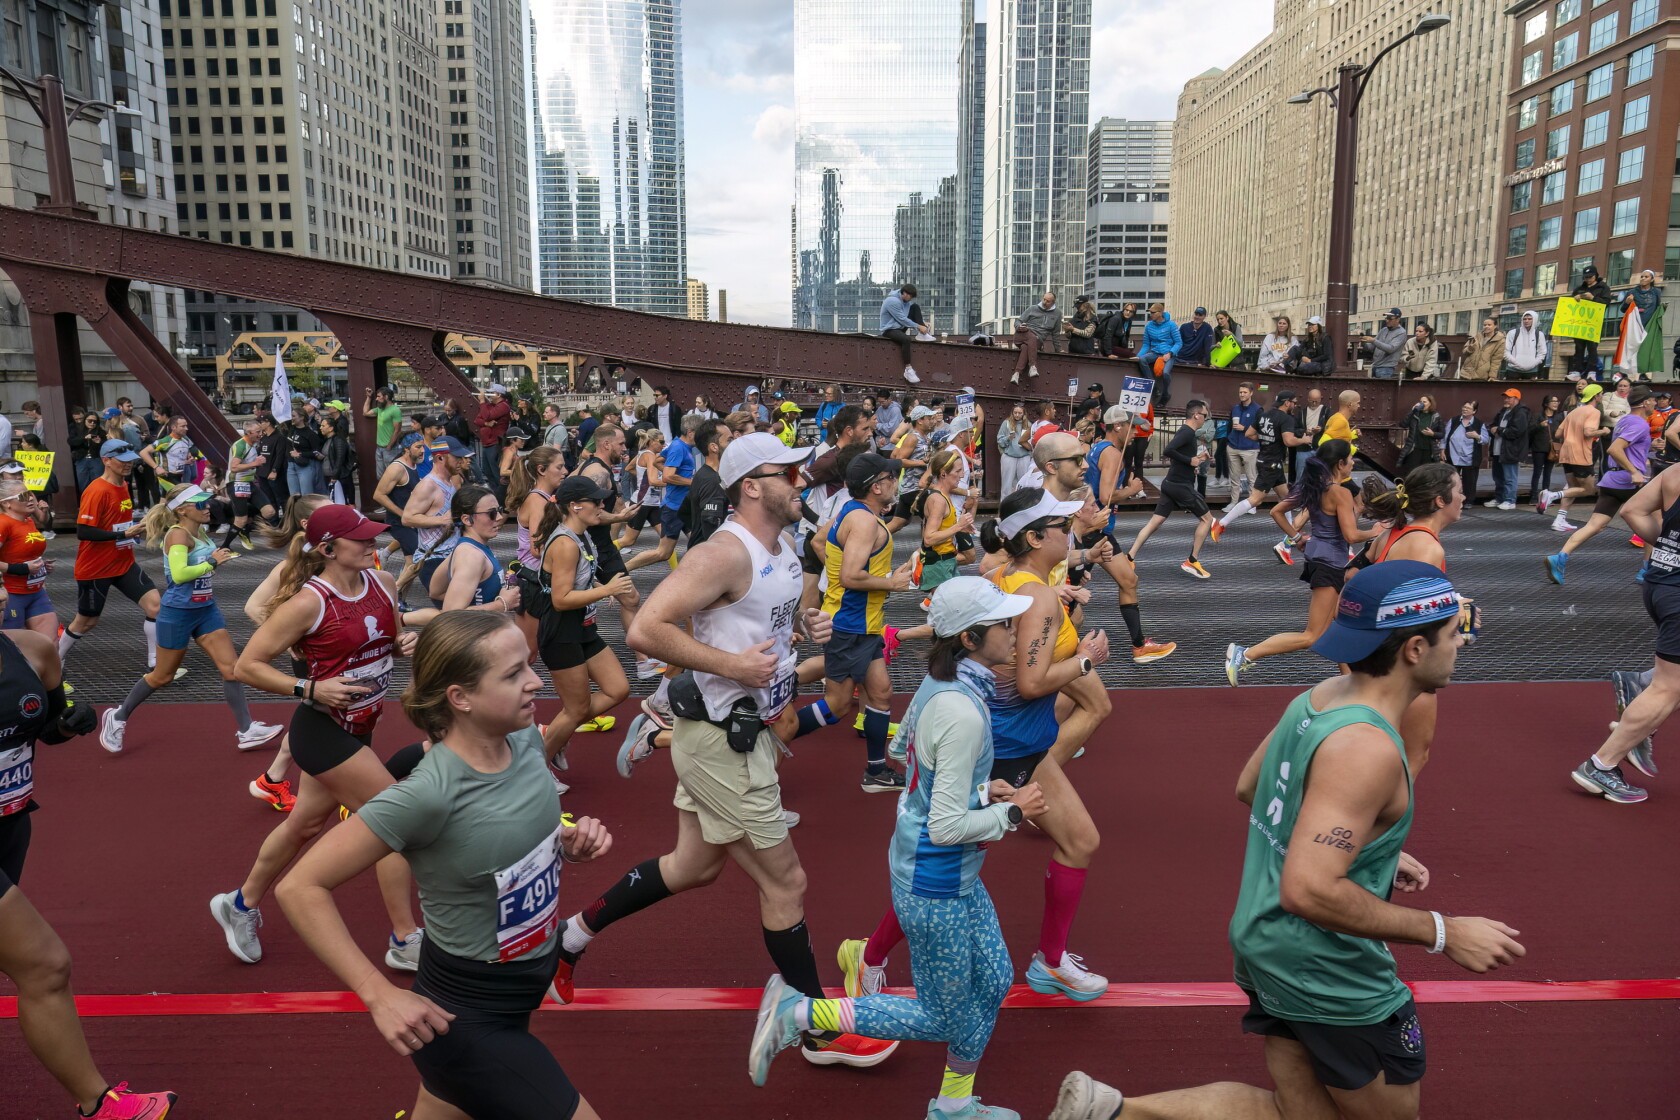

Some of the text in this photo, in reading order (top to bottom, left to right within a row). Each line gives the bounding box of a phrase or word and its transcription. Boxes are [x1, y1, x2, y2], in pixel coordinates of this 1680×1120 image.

[1567, 303, 1596, 319] YOU
[1558, 323, 1595, 339] THIS
[1122, 394, 1147, 407] 3:25
[959, 405, 973, 415] 3:25
[16, 453, 46, 462] LET'S GO
[703, 503, 718, 511] JULI
[770, 597, 797, 622] FLEET
[771, 610, 792, 633] FEET
[360, 647, 380, 661] JUDE
[770, 687, 778, 707] F
[0, 762, 32, 791] 440
[1331, 826, 1353, 840] GO
[500, 896, 516, 926] F
